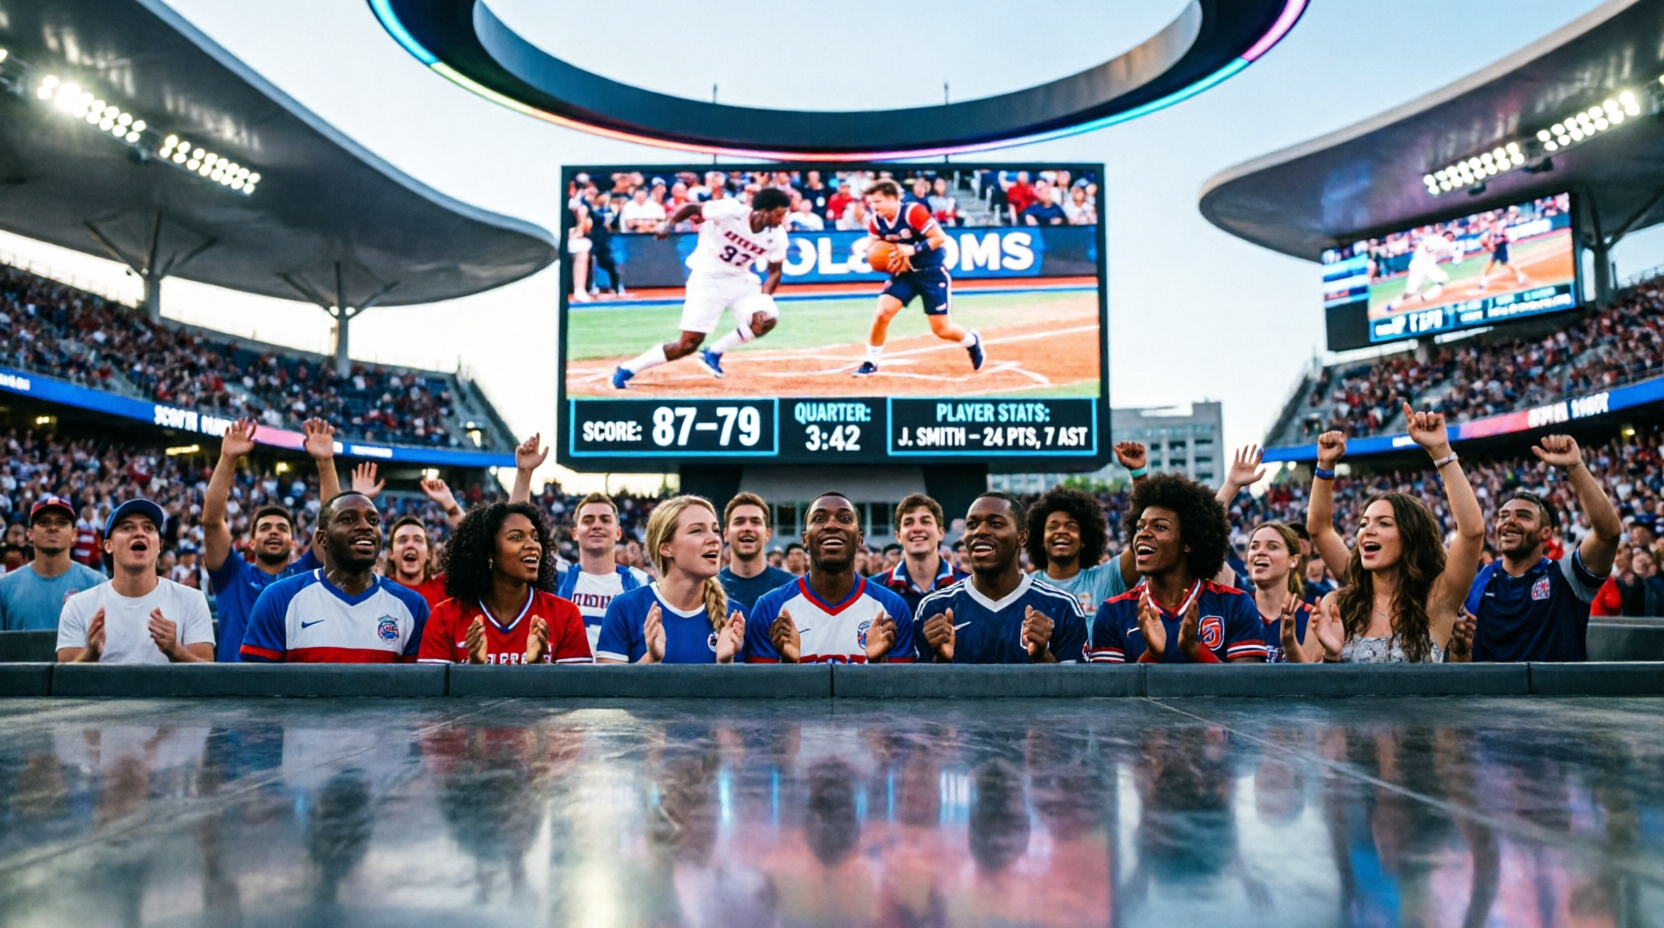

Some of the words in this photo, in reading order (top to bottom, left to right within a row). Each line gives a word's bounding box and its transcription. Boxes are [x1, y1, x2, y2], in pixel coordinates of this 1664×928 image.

[794, 402, 871, 424] QUARTER:
[936, 403, 995, 423] PLAYER
[998, 403, 1051, 423] STATS:
[582, 420, 643, 442] SCORE:
[805, 424, 861, 451] 3:42
[898, 427, 913, 447] J.
[916, 427, 966, 447] SMITH
[983, 427, 1004, 447] 24
[1006, 427, 1041, 449] PTS,
[1044, 427, 1055, 446] 7
[1057, 427, 1088, 446] AST
